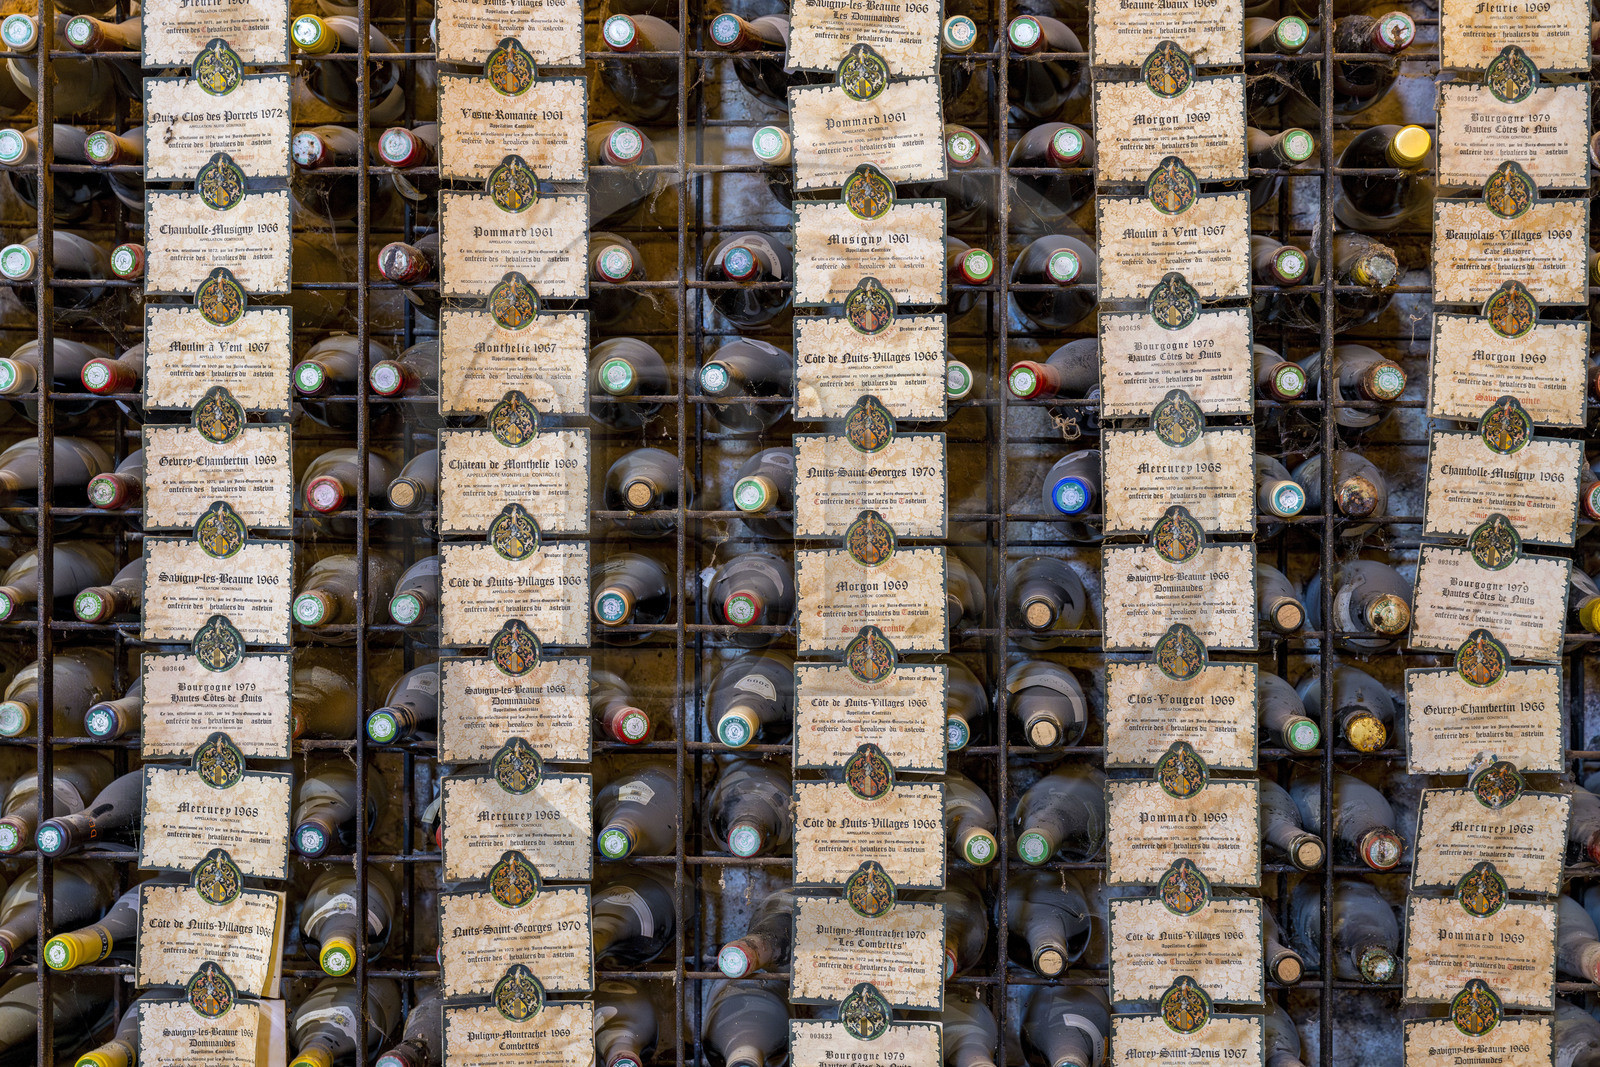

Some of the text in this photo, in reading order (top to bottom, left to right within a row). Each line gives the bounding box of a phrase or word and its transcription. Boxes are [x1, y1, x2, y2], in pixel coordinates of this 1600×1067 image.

[1475, 3, 1550, 14] Fleurie 1969
[182, 112, 203, 122] Clos
[207, 112, 221, 121] des
[224, 110, 258, 122] Porrets
[261, 109, 282, 118] 1972
[460, 108, 563, 121] Vosne-Romanée 1961
[1133, 113, 1210, 126] Morgon 1969
[1471, 113, 1550, 123] Bourgogne 1979
[825, 112, 906, 130] Pommard 1961
[1464, 125, 1558, 134] Hautes Côtes de Nuits
[159, 223, 278, 235] Chambolle-Musigny 1966
[473, 226, 553, 238] Pommard 1961
[1122, 226, 1226, 239] Moulin à Vent 1967
[1445, 229, 1572, 241] Beaujolais-Villages 1969
[827, 234, 909, 246] Musigny 1961
[169, 341, 269, 352] Moulin à Vent 1967
[473, 342, 556, 354] Monthelie 1967
[1134, 340, 1214, 351] Bourgogne 1979
[804, 352, 938, 364] Côte de Nuits-Villages 1966
[1128, 351, 1221, 363] Hautes Côtes de Nuits
[1472, 350, 1546, 363] Morgon 1969
[159, 456, 277, 467] Gevrey-Chambertin 1969
[448, 459, 578, 471] Château de Monthelie 1969
[806, 467, 935, 479] Nuits-Saint-Georges 1970
[1137, 463, 1222, 474] Mercurey 1968
[1441, 465, 1564, 482] Chambolle-Musigny 1966
[158, 572, 279, 585] Savigny-les-Beaune 1966
[448, 577, 581, 589] Côte de Nuits-Villages 1966
[1127, 573, 1206, 583] Savigny-les-Beaune
[836, 581, 908, 592] Morgon 1969
[1154, 584, 1203, 592] Dominaudes
[1449, 577, 1529, 593] Bourgogne 1979
[1442, 588, 1535, 605] Hautes Côtes de Nuits
[178, 683, 256, 692] Bourgogne 1979
[464, 685, 543, 696] Savigny-les-Beaune
[171, 693, 262, 704] Hautes Côtes de Nuits
[492, 697, 541, 705] Dominaudes
[811, 698, 927, 708] Côte de Nuits-Villages 1966
[1128, 694, 1234, 706] Clos-Vougeot 1969
[1423, 702, 1545, 716] Gevrey-Chambertin 1966
[177, 802, 258, 817] Mercurey 1968
[477, 811, 560, 822] Mercurey 1968
[1139, 812, 1228, 825] Pommard 1969
[803, 818, 936, 830] Côte de Nuits-Villages 1966
[1451, 822, 1533, 835] Mercurey 1968
[149, 919, 272, 938] Côte de Nuits-Villages 1966
[452, 921, 581, 938] Nuits-Saint-Georges 1970
[816, 925, 926, 939] Puligny-Montrachet 1970
[1126, 933, 1143, 941] Côte
[1158, 931, 1220, 941] Nuits-Villages
[1224, 932, 1243, 940] 1966
[1437, 929, 1525, 944] Pommard 1969
[467, 1029, 570, 1041] Puligny-Montrachet 1969
[499, 1042, 539, 1050] Combettes
[1429, 1045, 1506, 1055] Savigny-les-Beaune
[825, 1051, 905, 1061] Bourgogne 1979
[1125, 1048, 1248, 1060] Morey-Saint-Denis 1967
[1454, 1056, 1503, 1065] Dominaudes
